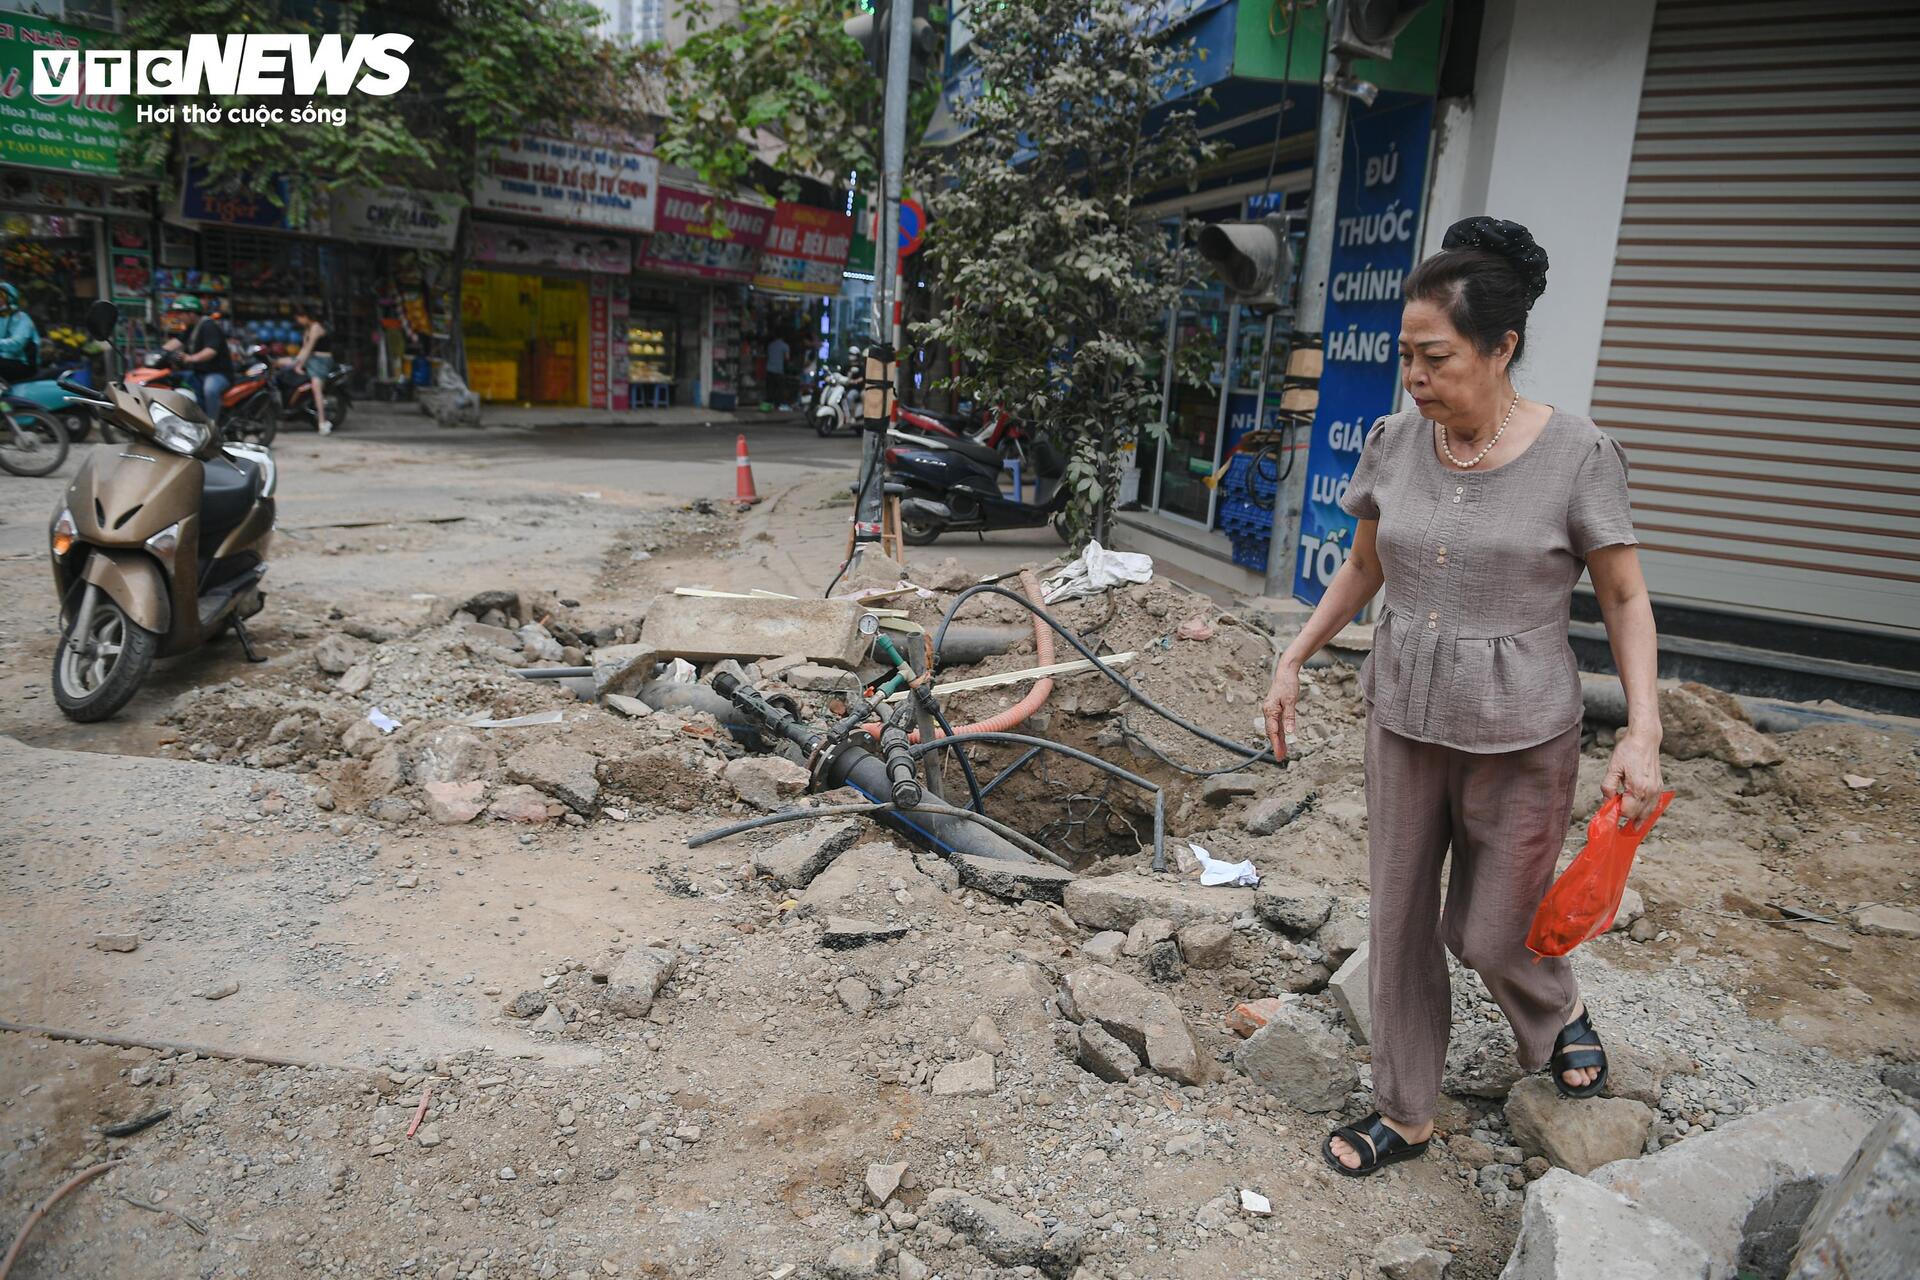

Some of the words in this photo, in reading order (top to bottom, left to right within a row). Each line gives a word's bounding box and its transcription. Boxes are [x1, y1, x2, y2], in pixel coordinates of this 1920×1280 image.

[1364, 142, 1399, 187] ĐỦ
[203, 196, 259, 222] Tiger
[1339, 199, 1414, 247] THUỐC
[1331, 262, 1403, 302] CHÍNH
[1327, 324, 1391, 363] HÃNG
[1328, 416, 1364, 454] GIÁ
[1311, 472, 1351, 507] LUÔ
[1300, 528, 1352, 587] TỐ
